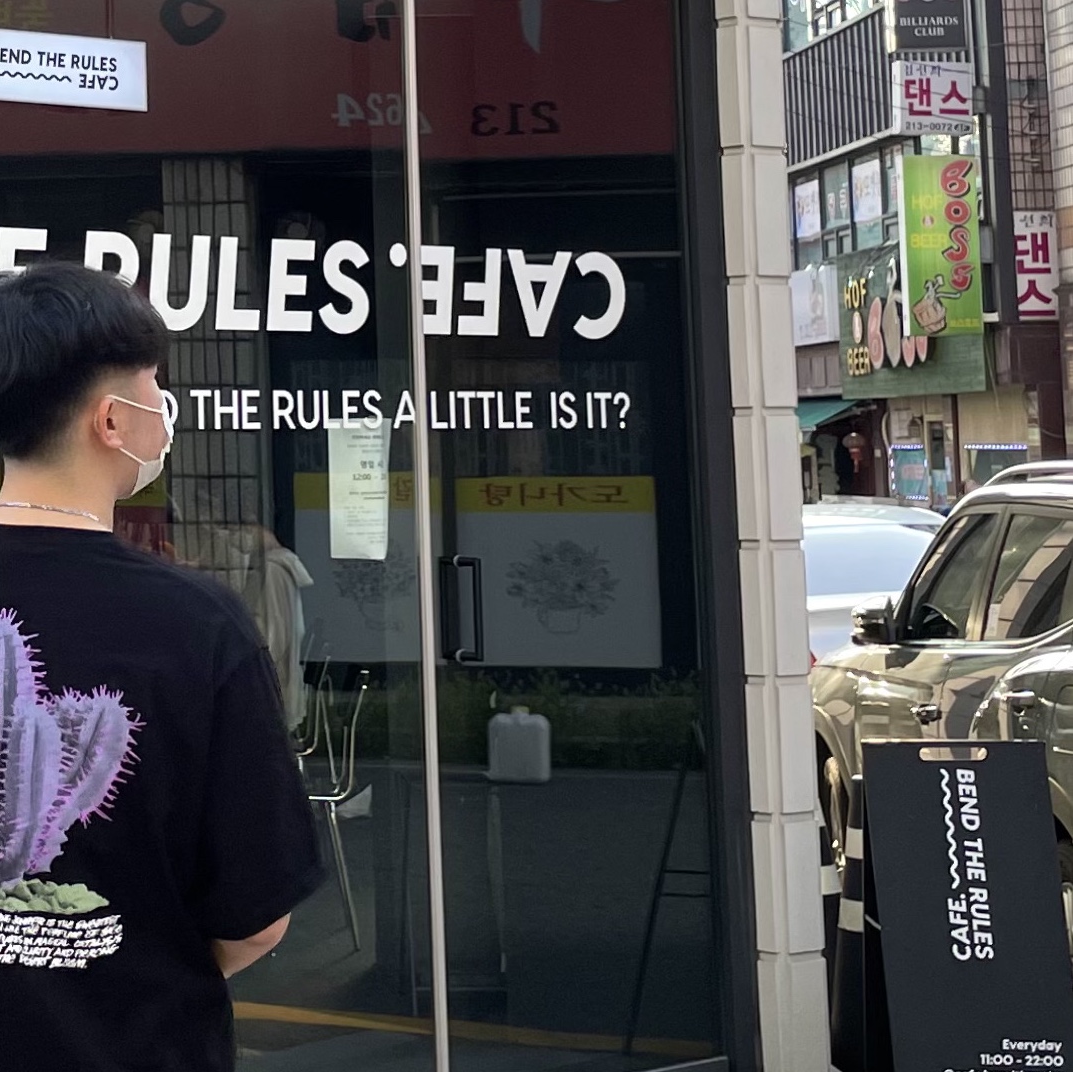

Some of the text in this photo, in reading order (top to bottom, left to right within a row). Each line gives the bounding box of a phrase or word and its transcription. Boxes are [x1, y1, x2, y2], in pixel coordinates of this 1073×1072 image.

[899, 16, 959, 27] BILLIARDS
[914, 26, 945, 37] CLUB
[37, 51, 66, 68] THE
[71, 54, 117, 73] RULES
[78, 73, 119, 91] CAFE
[904, 77, 970, 116] 댄스
[190, 389, 262, 430] THE
[272, 389, 384, 430] RULES
[393, 390, 416, 430] A
[430, 390, 534, 430] LITTLE
[550, 391, 578, 430] IS
[586, 392, 631, 430] IT?
[956, 768, 995, 960] BEND THE RULES
[1002, 1038, 1063, 1053] Everyday
[980, 1053, 1014, 1066] 11:00
[1025, 1055, 1064, 1067] 22:00
